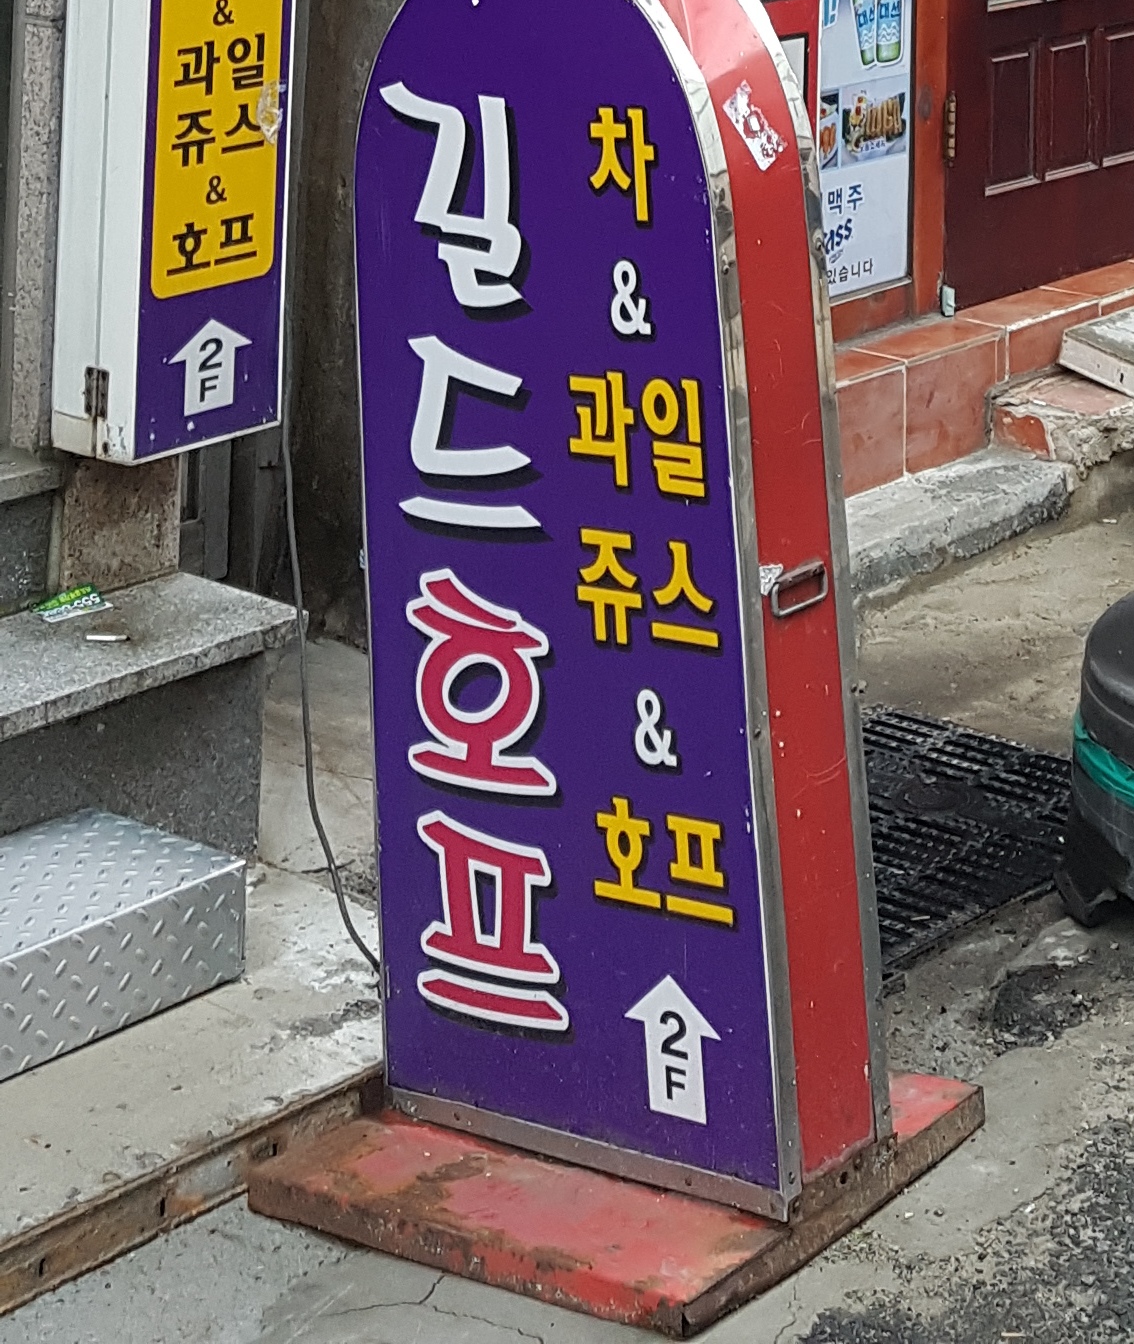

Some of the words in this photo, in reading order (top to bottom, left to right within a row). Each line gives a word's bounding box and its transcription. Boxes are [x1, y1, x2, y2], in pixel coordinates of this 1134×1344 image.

[173, 33, 266, 96] 과일
[206, 175, 228, 204] &
[589, 108, 654, 222] 차
[166, 214, 258, 276] 호프
[611, 260, 652, 336] &
[569, 371, 706, 499] 과일
[577, 527, 719, 649] 쥬스
[634, 688, 678, 768] &
[594, 797, 734, 926] 호프
